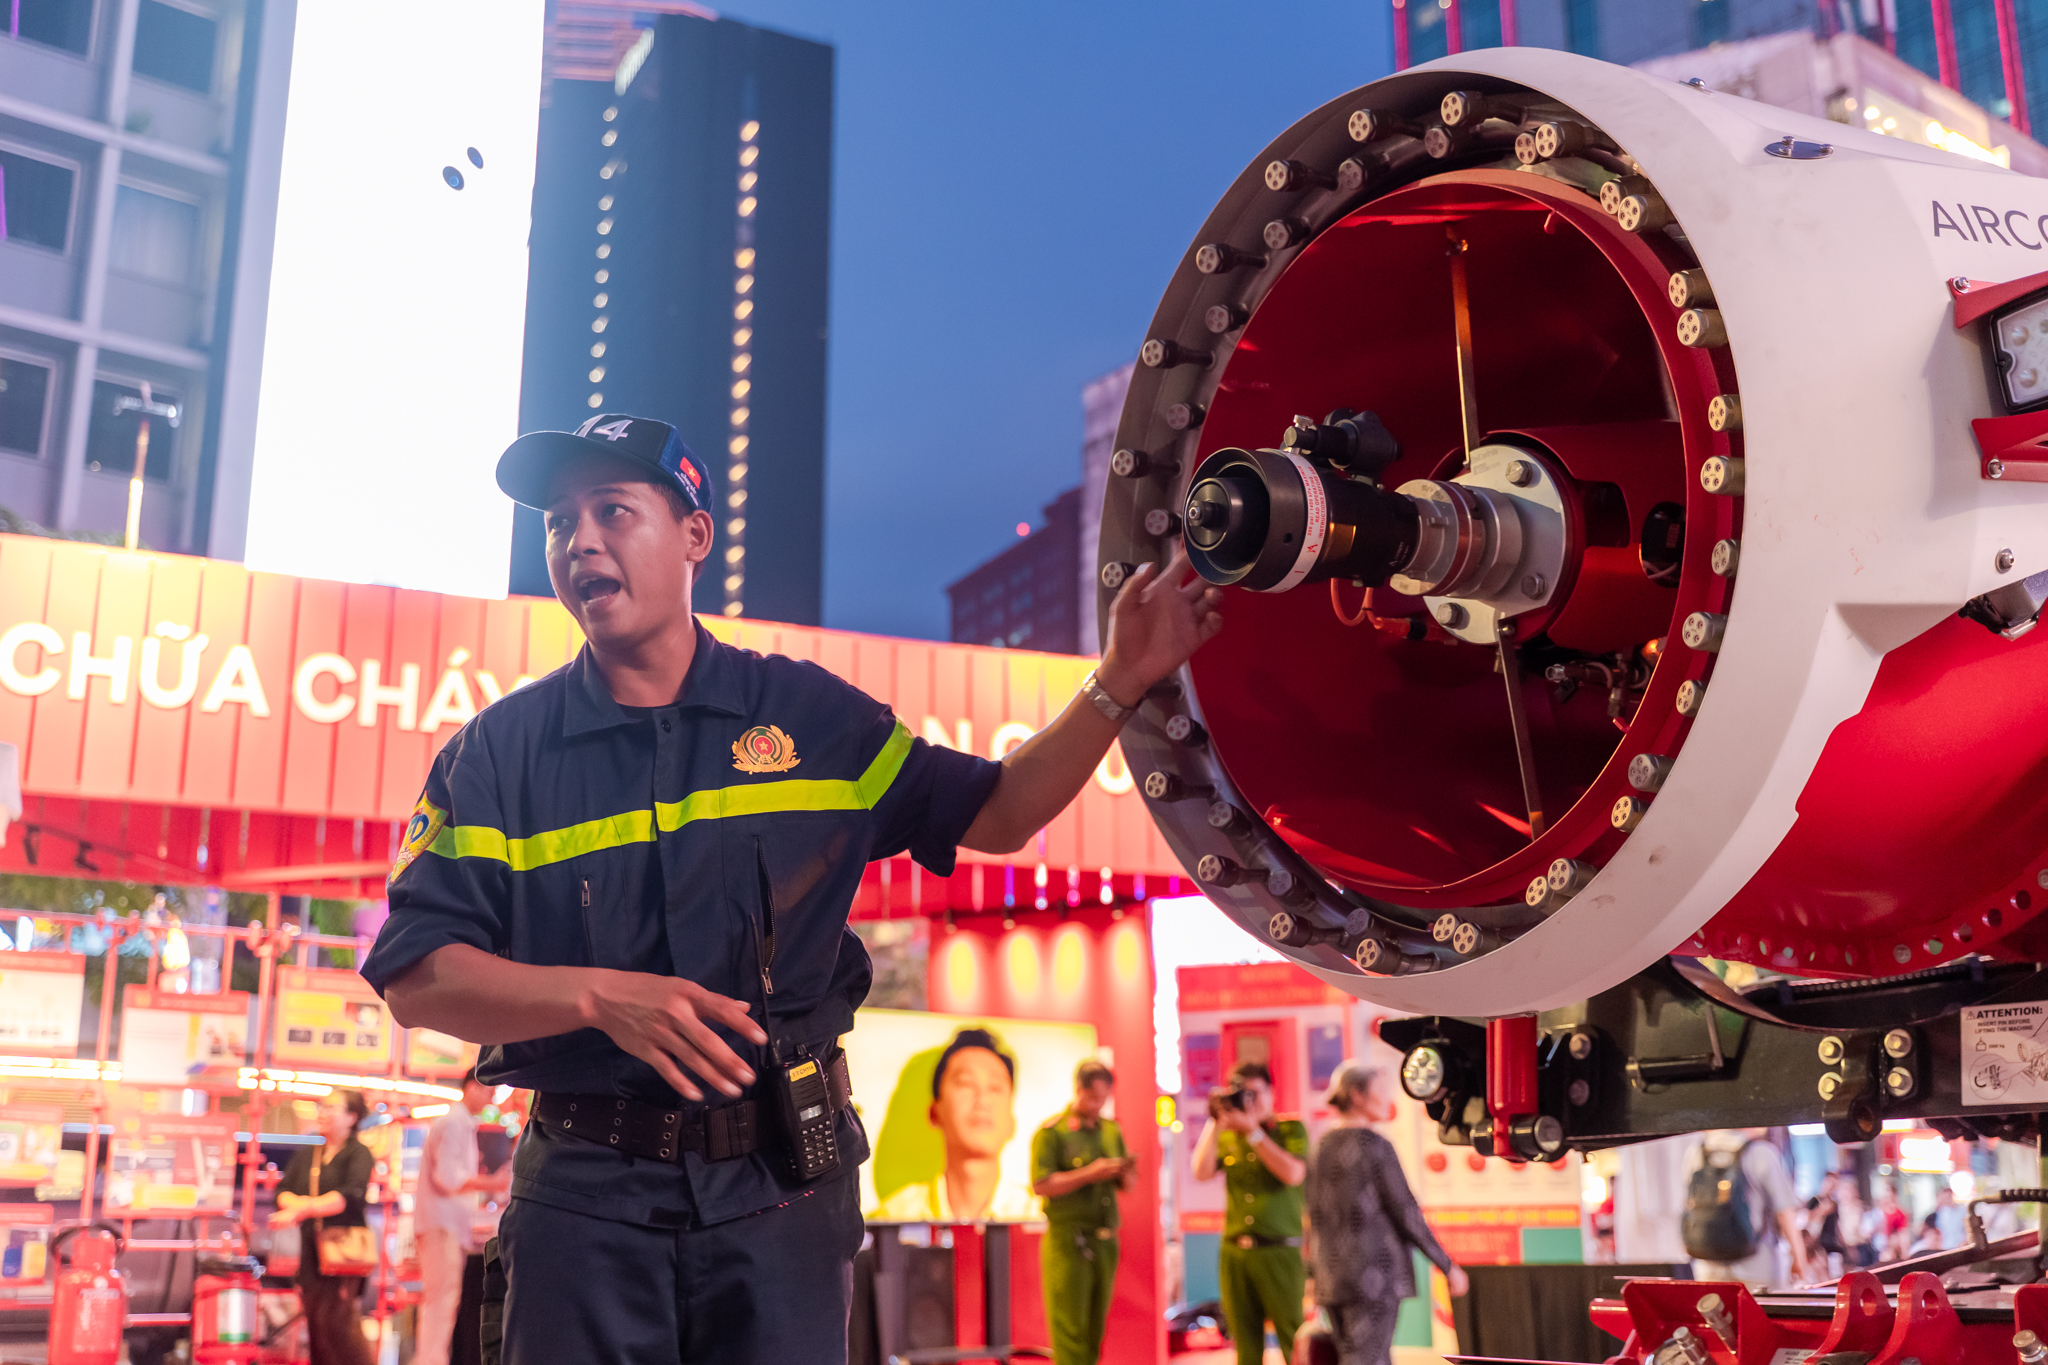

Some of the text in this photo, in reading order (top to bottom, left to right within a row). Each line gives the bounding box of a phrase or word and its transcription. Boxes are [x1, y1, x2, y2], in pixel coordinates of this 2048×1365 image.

[1932, 200, 2048, 250] AIRC
[1298, 466, 1309, 486] MAXIMUM
[1313, 476, 1323, 495] BEFORE
[1309, 476, 1319, 505] OPERATING
[0, 620, 271, 718] CHỮA
[1977, 1006, 2043, 1019] ATTENTION:
